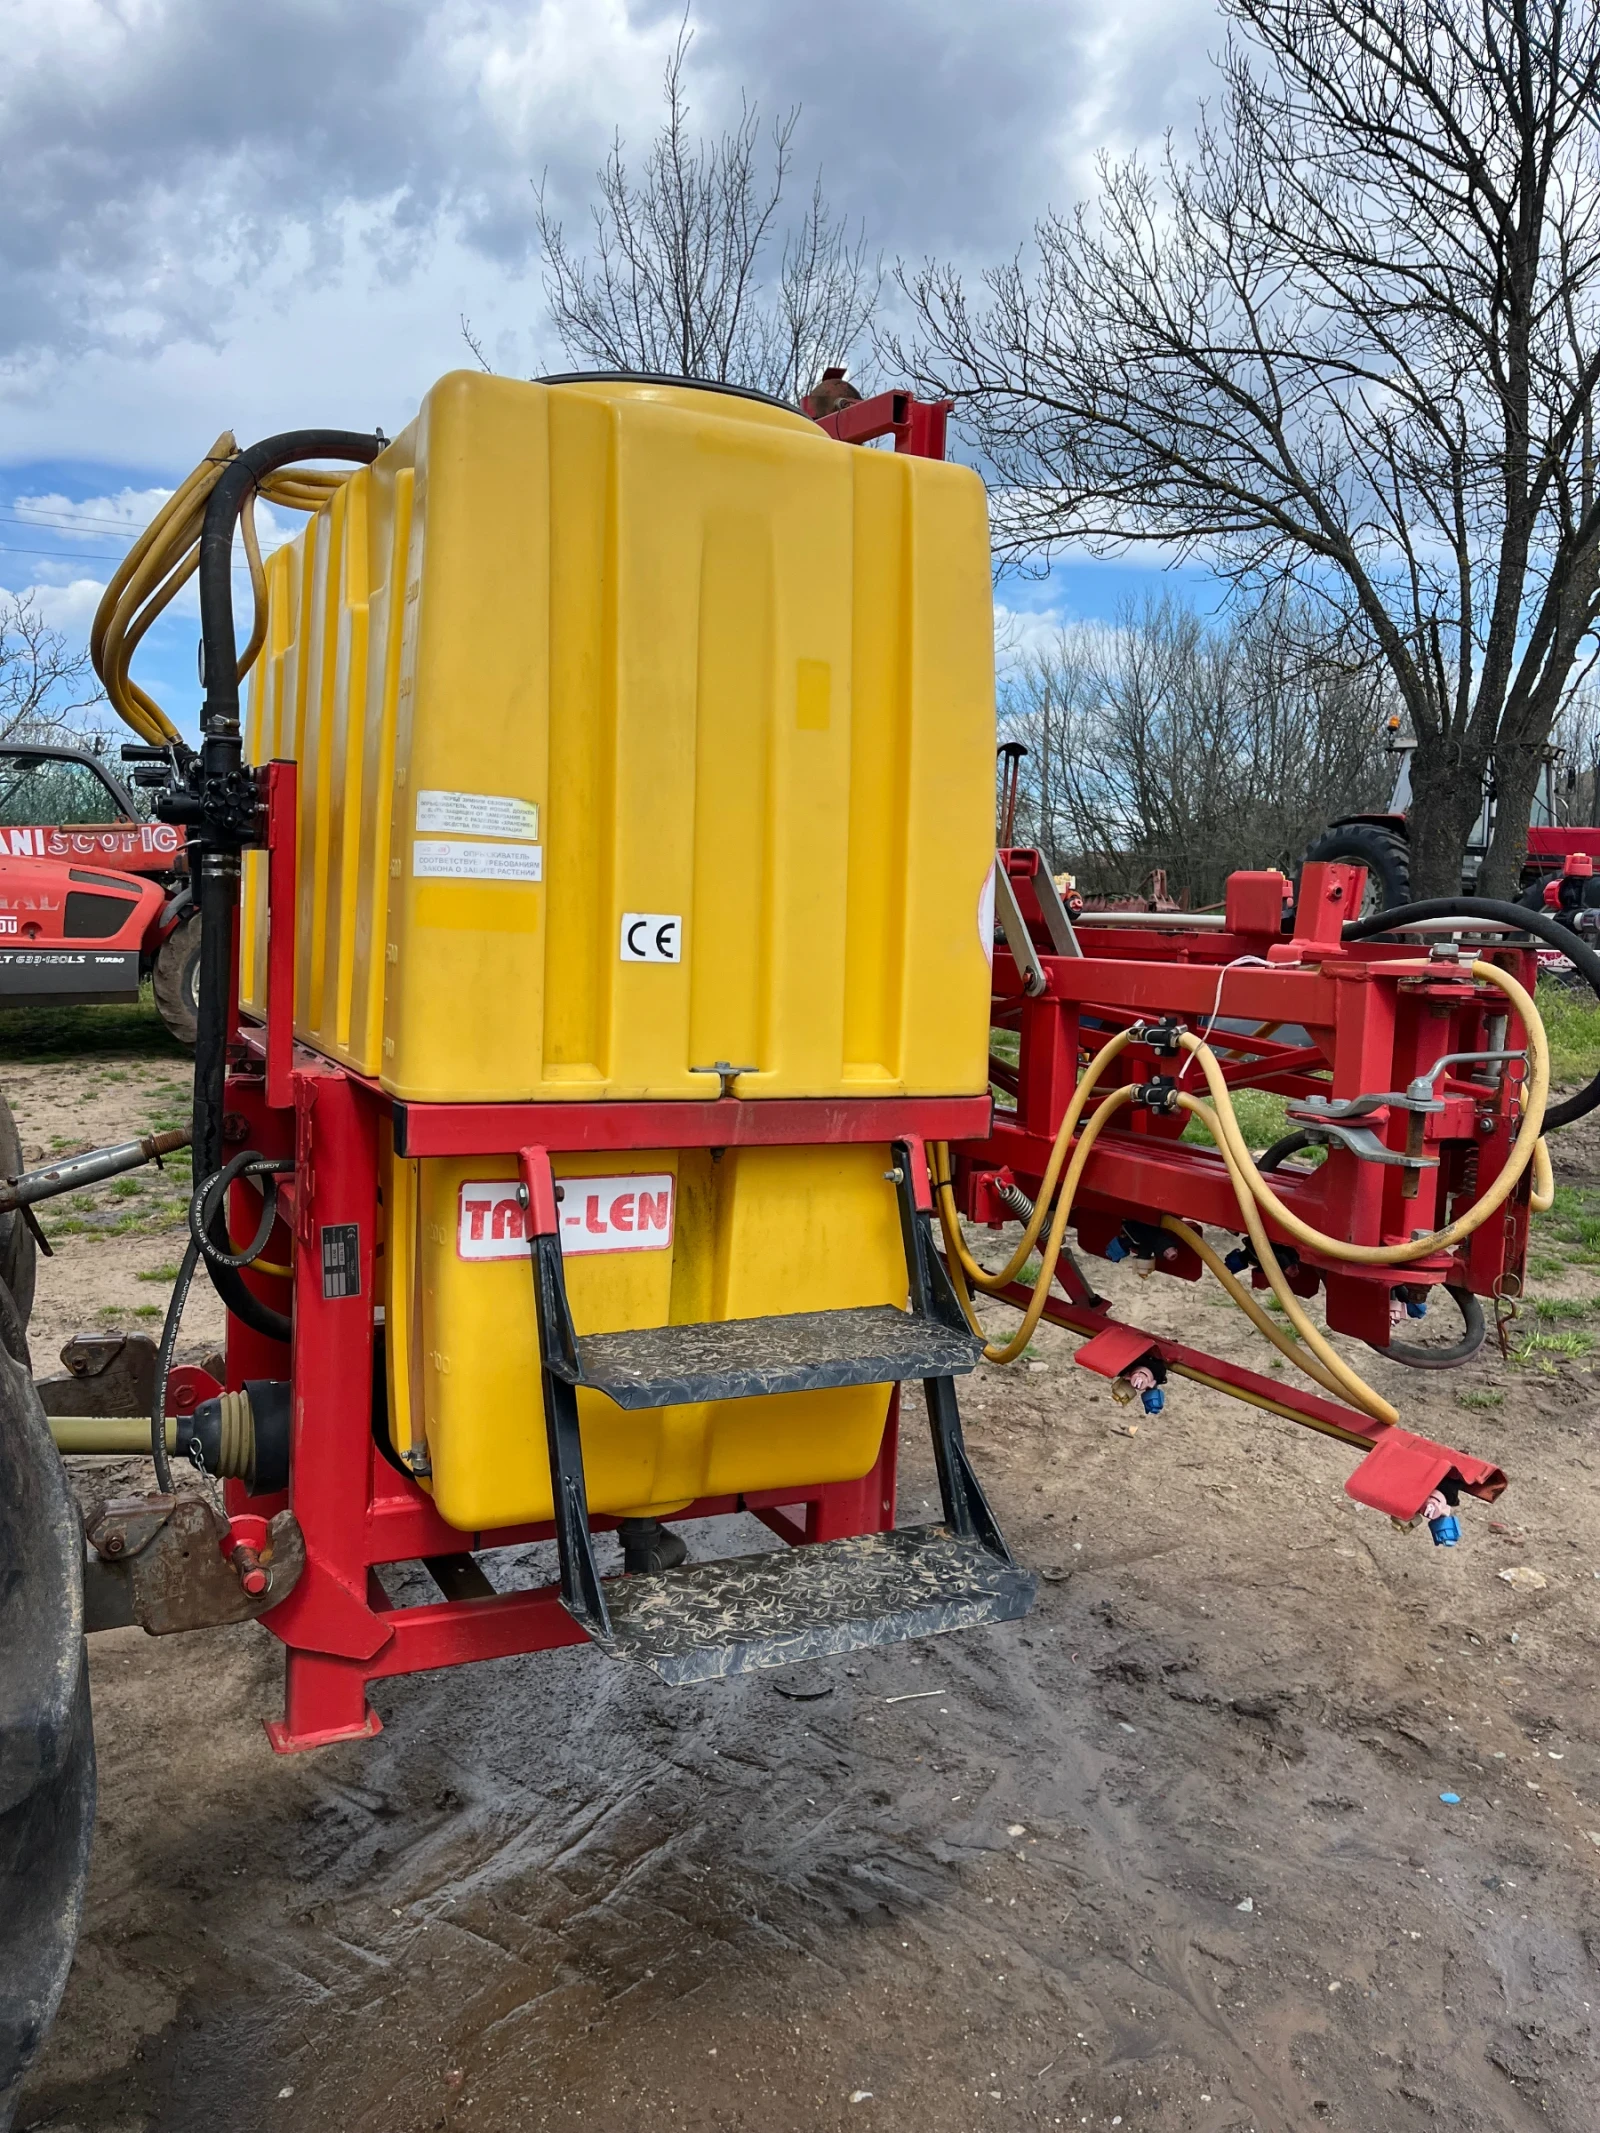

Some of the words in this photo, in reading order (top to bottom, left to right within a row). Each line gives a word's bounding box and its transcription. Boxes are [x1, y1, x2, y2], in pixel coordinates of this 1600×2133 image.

[422, 865, 454, 873] ЗАКОНА
[94, 956, 125, 964] TURBO
[465, 1191, 669, 1241] TA-LEN
